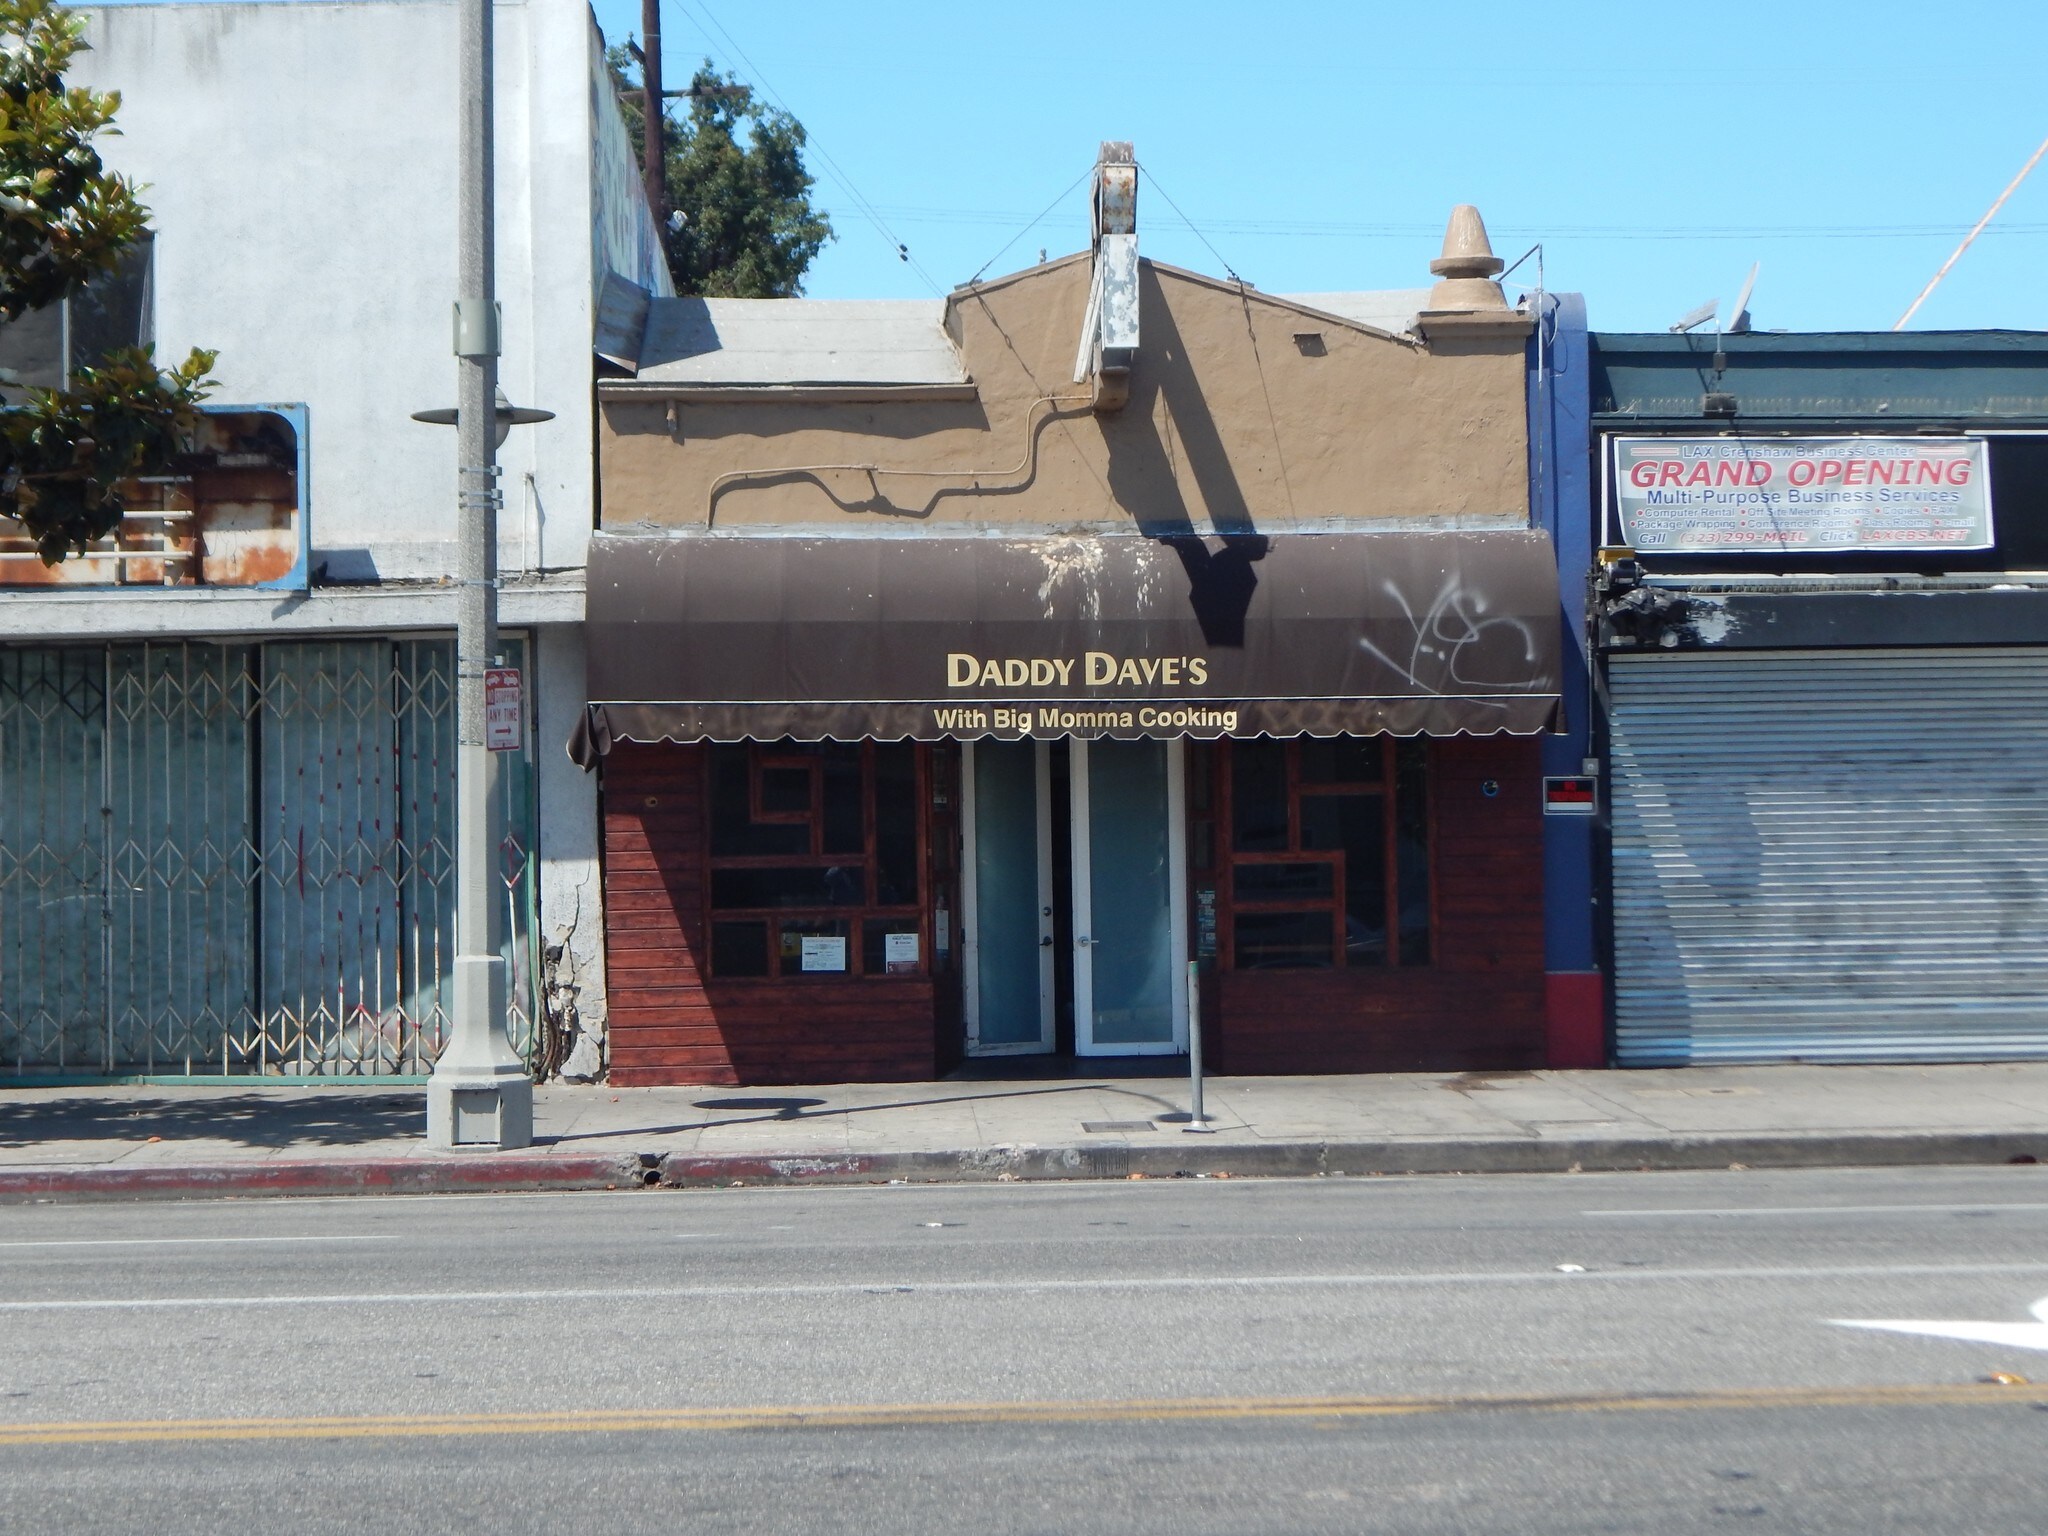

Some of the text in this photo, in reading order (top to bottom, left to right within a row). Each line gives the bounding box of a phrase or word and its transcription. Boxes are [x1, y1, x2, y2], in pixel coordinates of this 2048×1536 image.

[1683, 445, 1914, 458] LAX Crenshaw Business Center
[1630, 458, 1972, 488] GRAND OPENING
[1647, 488, 1960, 506] Multi-Purpose Business Services
[1645, 509, 1698, 518] Computer
[1701, 508, 1735, 517] Rental
[1637, 520, 1683, 530] Package
[1685, 520, 1736, 530] Wrapping
[1639, 533, 1667, 544] Call
[1819, 531, 1854, 541] Click
[947, 652, 1208, 687] DADDY DAVE'S
[489, 708, 518, 722] ANY TIME
[934, 707, 1238, 733] With Big Momma Cooking
